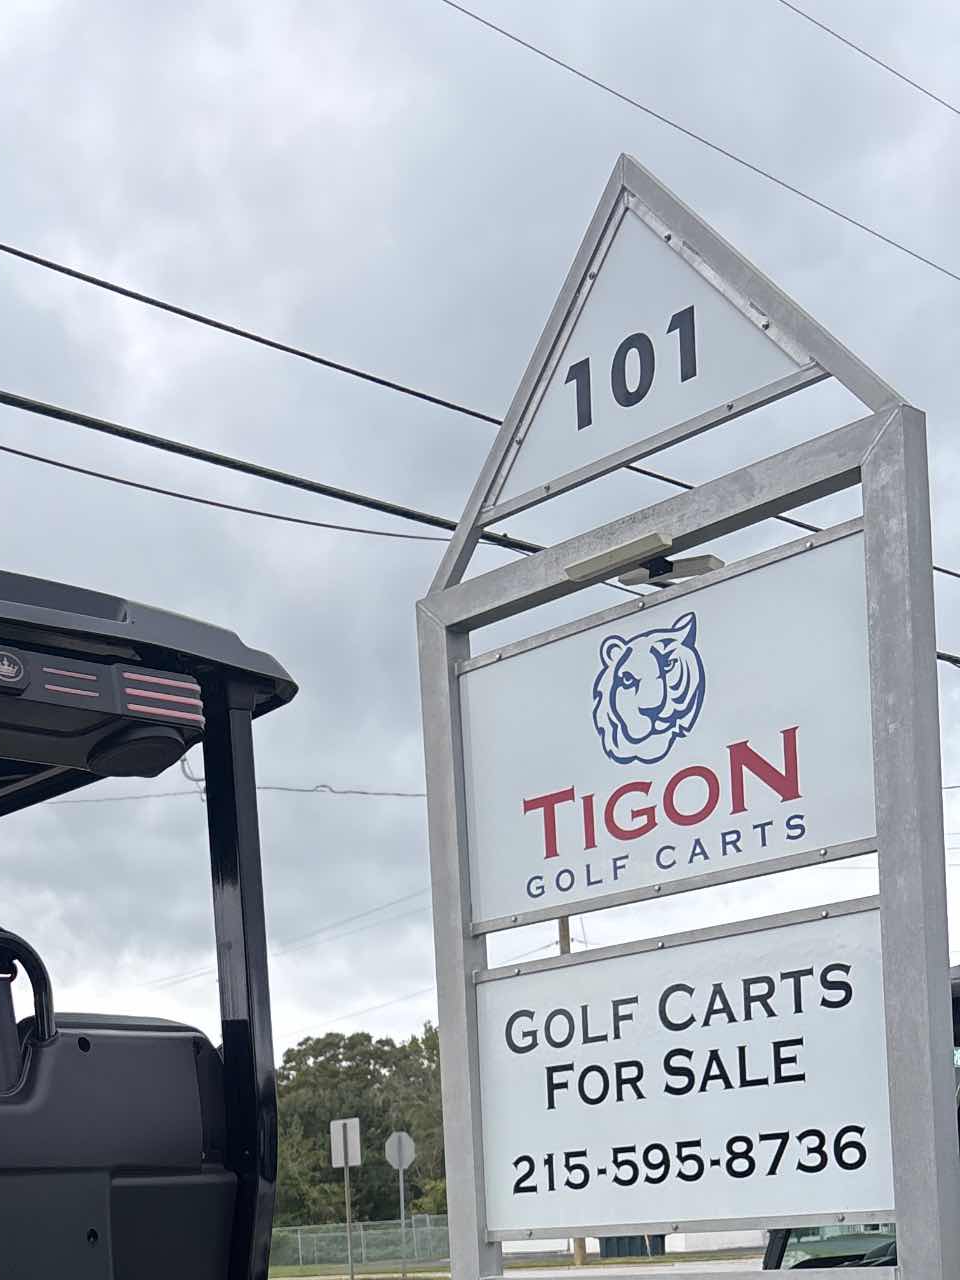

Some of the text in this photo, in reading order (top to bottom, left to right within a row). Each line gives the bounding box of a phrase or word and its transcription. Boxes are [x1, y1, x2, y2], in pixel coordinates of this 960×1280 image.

[564, 305, 698, 431] 101
[523, 727, 802, 858] TIGON
[526, 814, 806, 899] GOLF CARTS
[505, 963, 853, 1054] GOLF CARTS
[546, 1036, 806, 1110] FOR SALE
[513, 1125, 867, 1194] 215-595-8736
